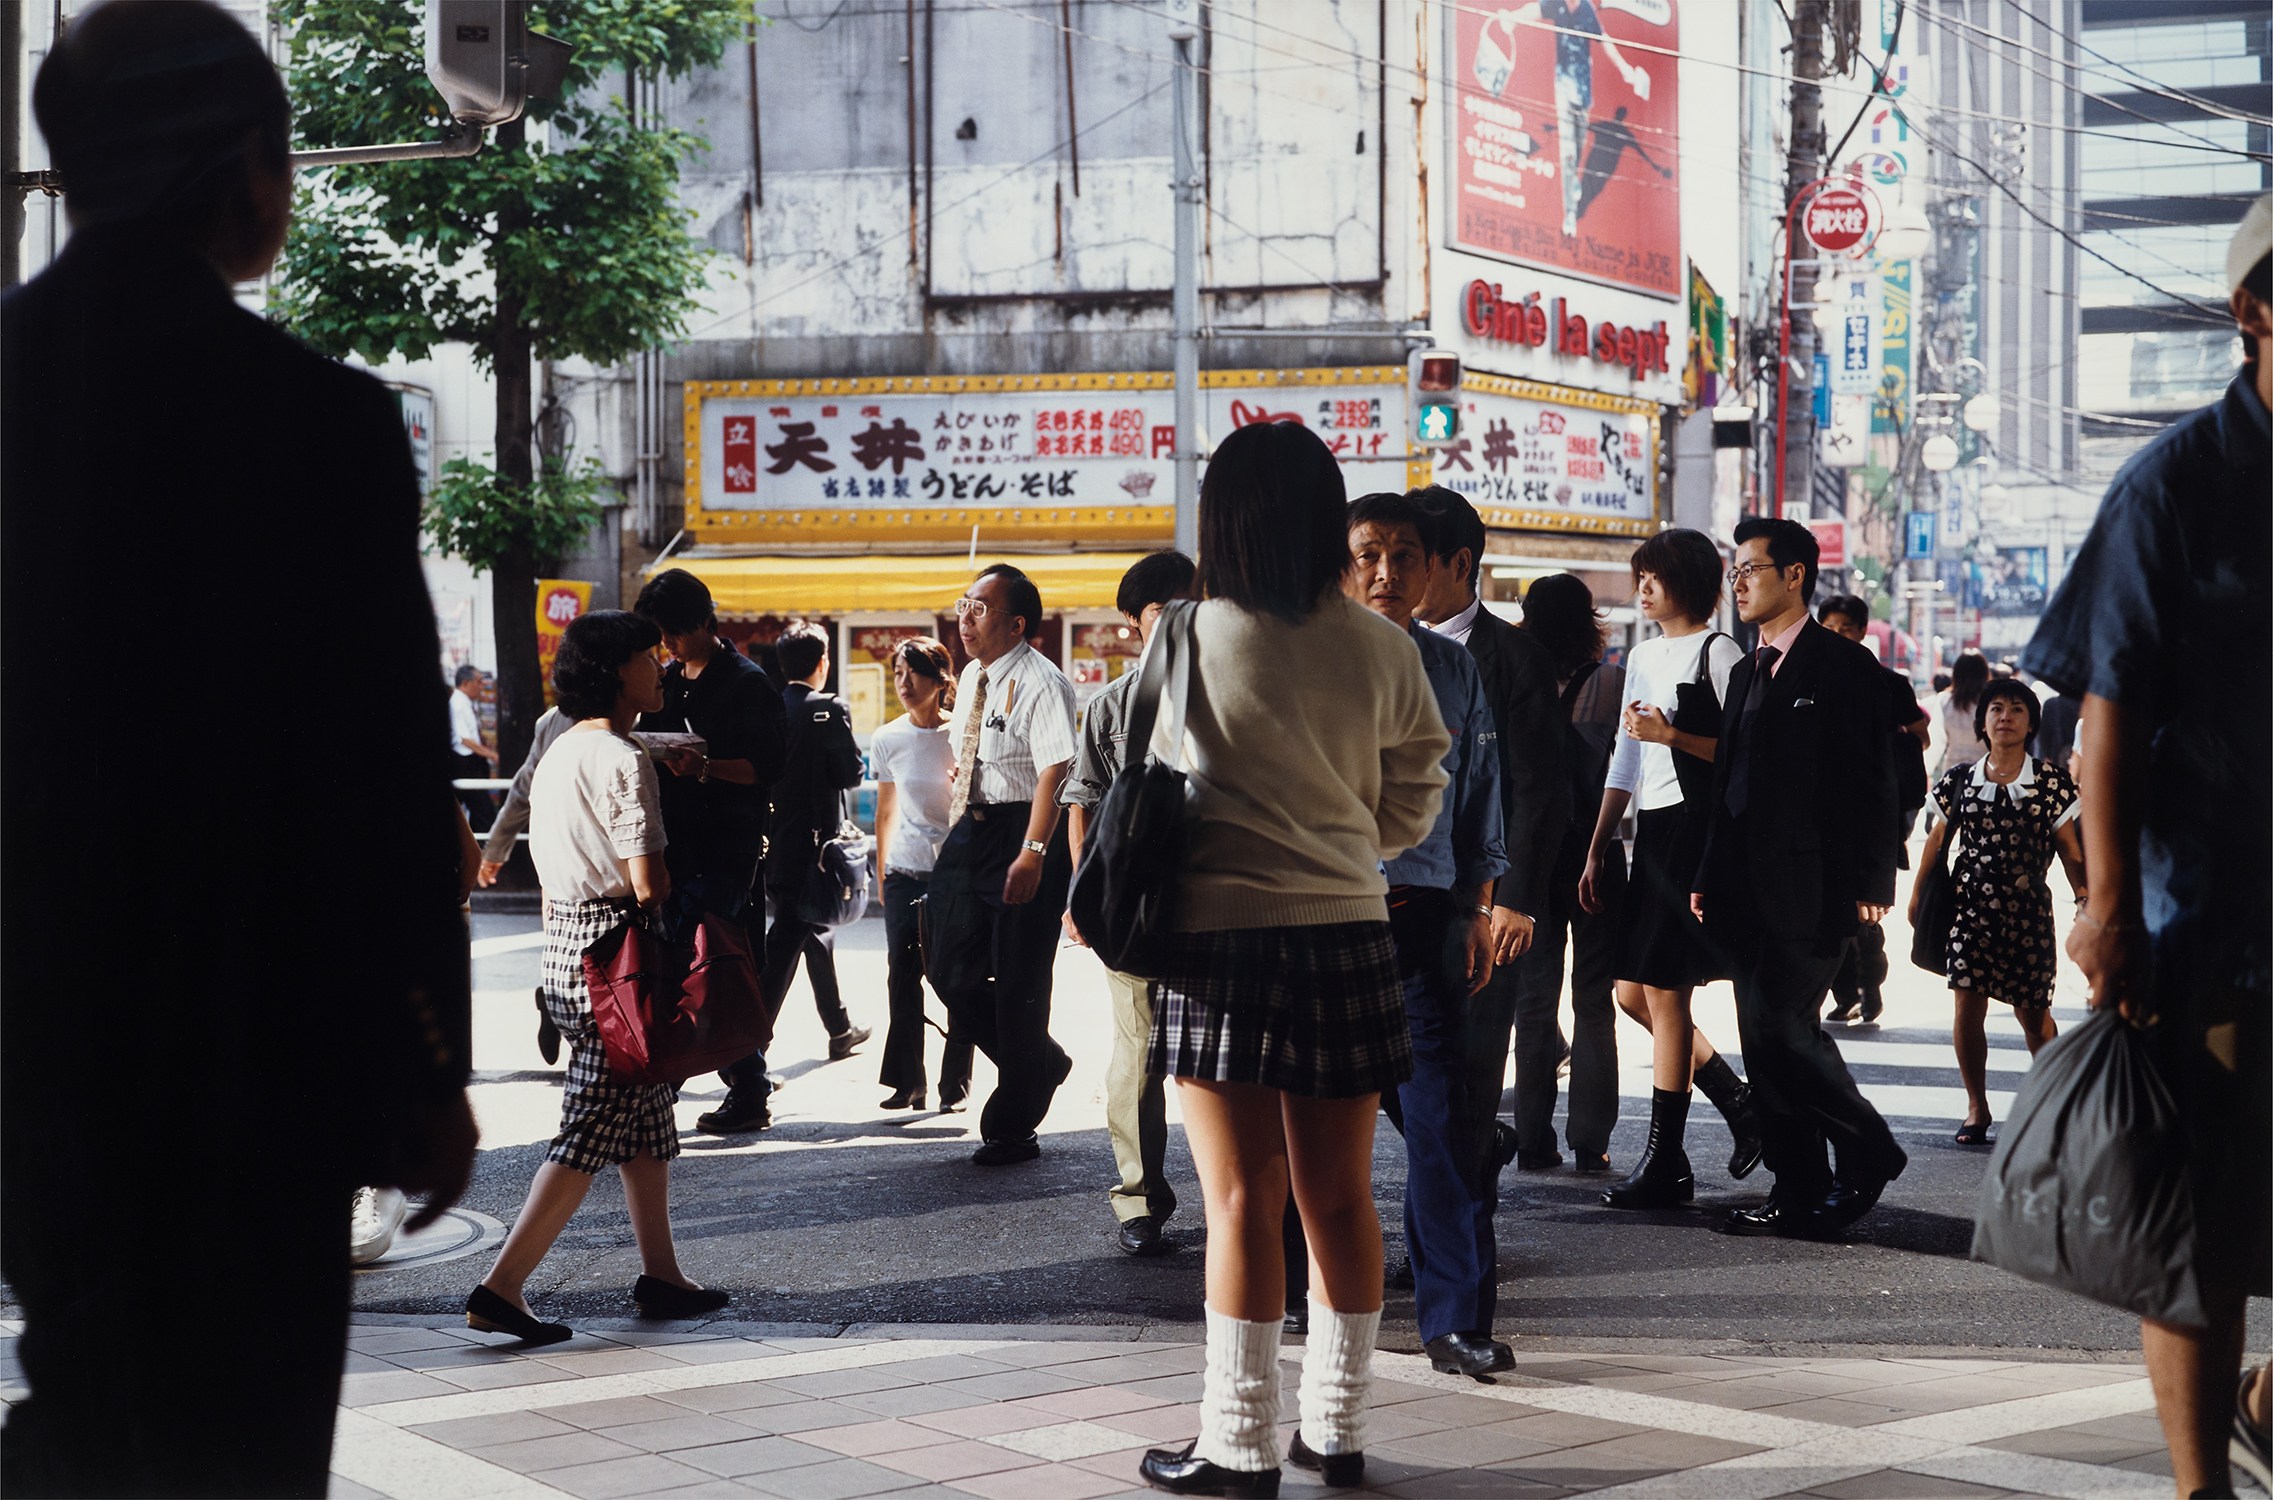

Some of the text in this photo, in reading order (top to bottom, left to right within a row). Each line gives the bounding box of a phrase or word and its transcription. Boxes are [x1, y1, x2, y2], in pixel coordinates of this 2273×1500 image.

[1810, 207, 1865, 234] 消火栓
[1462, 278, 1670, 382] Ciné la sept
